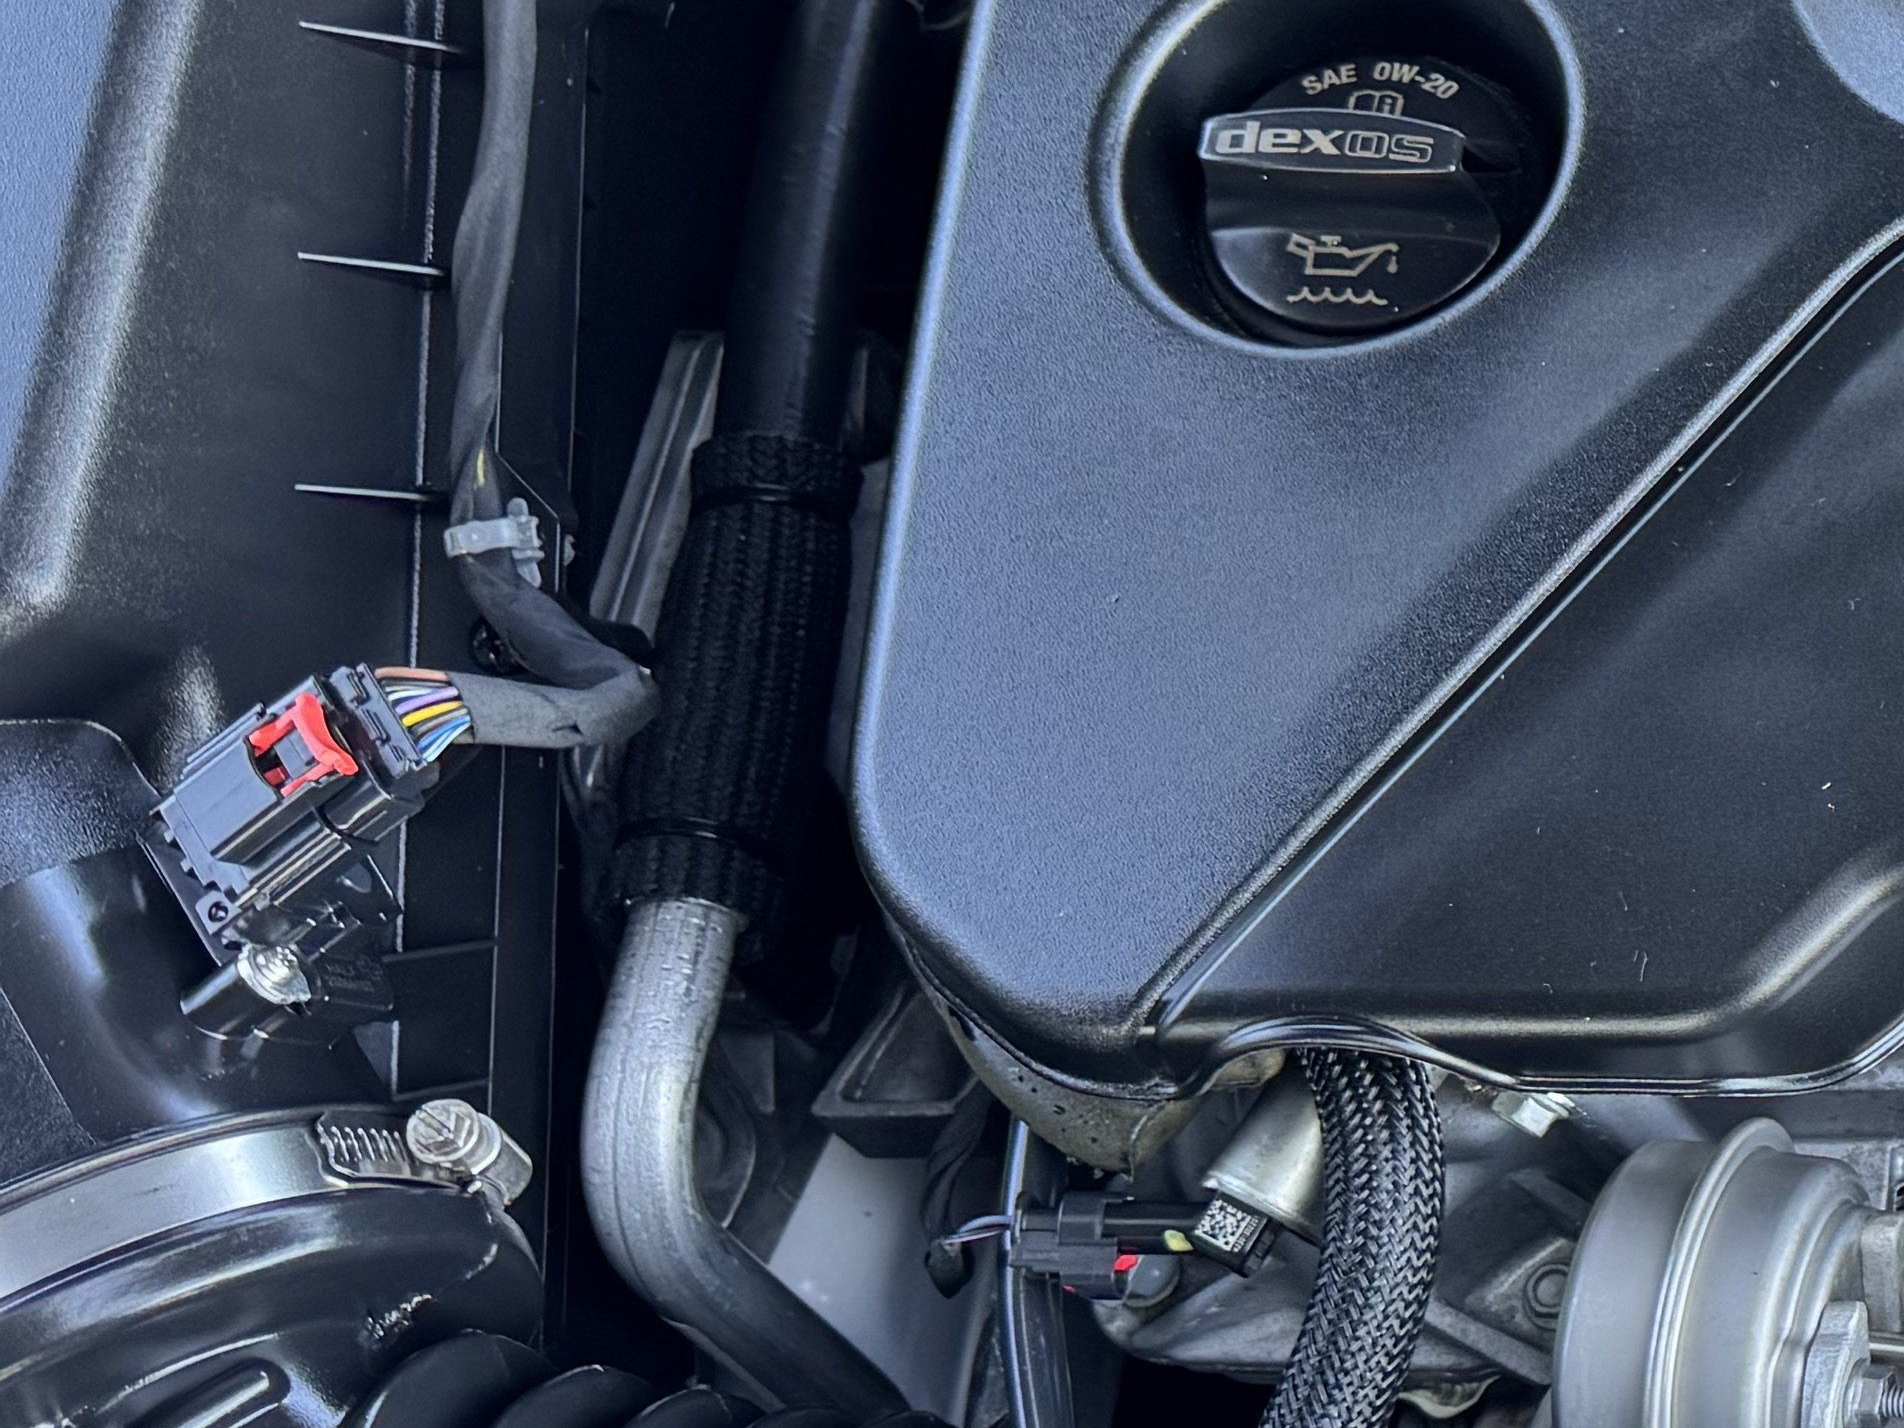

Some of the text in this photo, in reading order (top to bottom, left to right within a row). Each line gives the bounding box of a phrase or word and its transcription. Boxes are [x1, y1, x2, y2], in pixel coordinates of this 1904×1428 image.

[1302, 61, 1460, 100] SAE 0W-20
[1214, 120, 1435, 164] dexos
